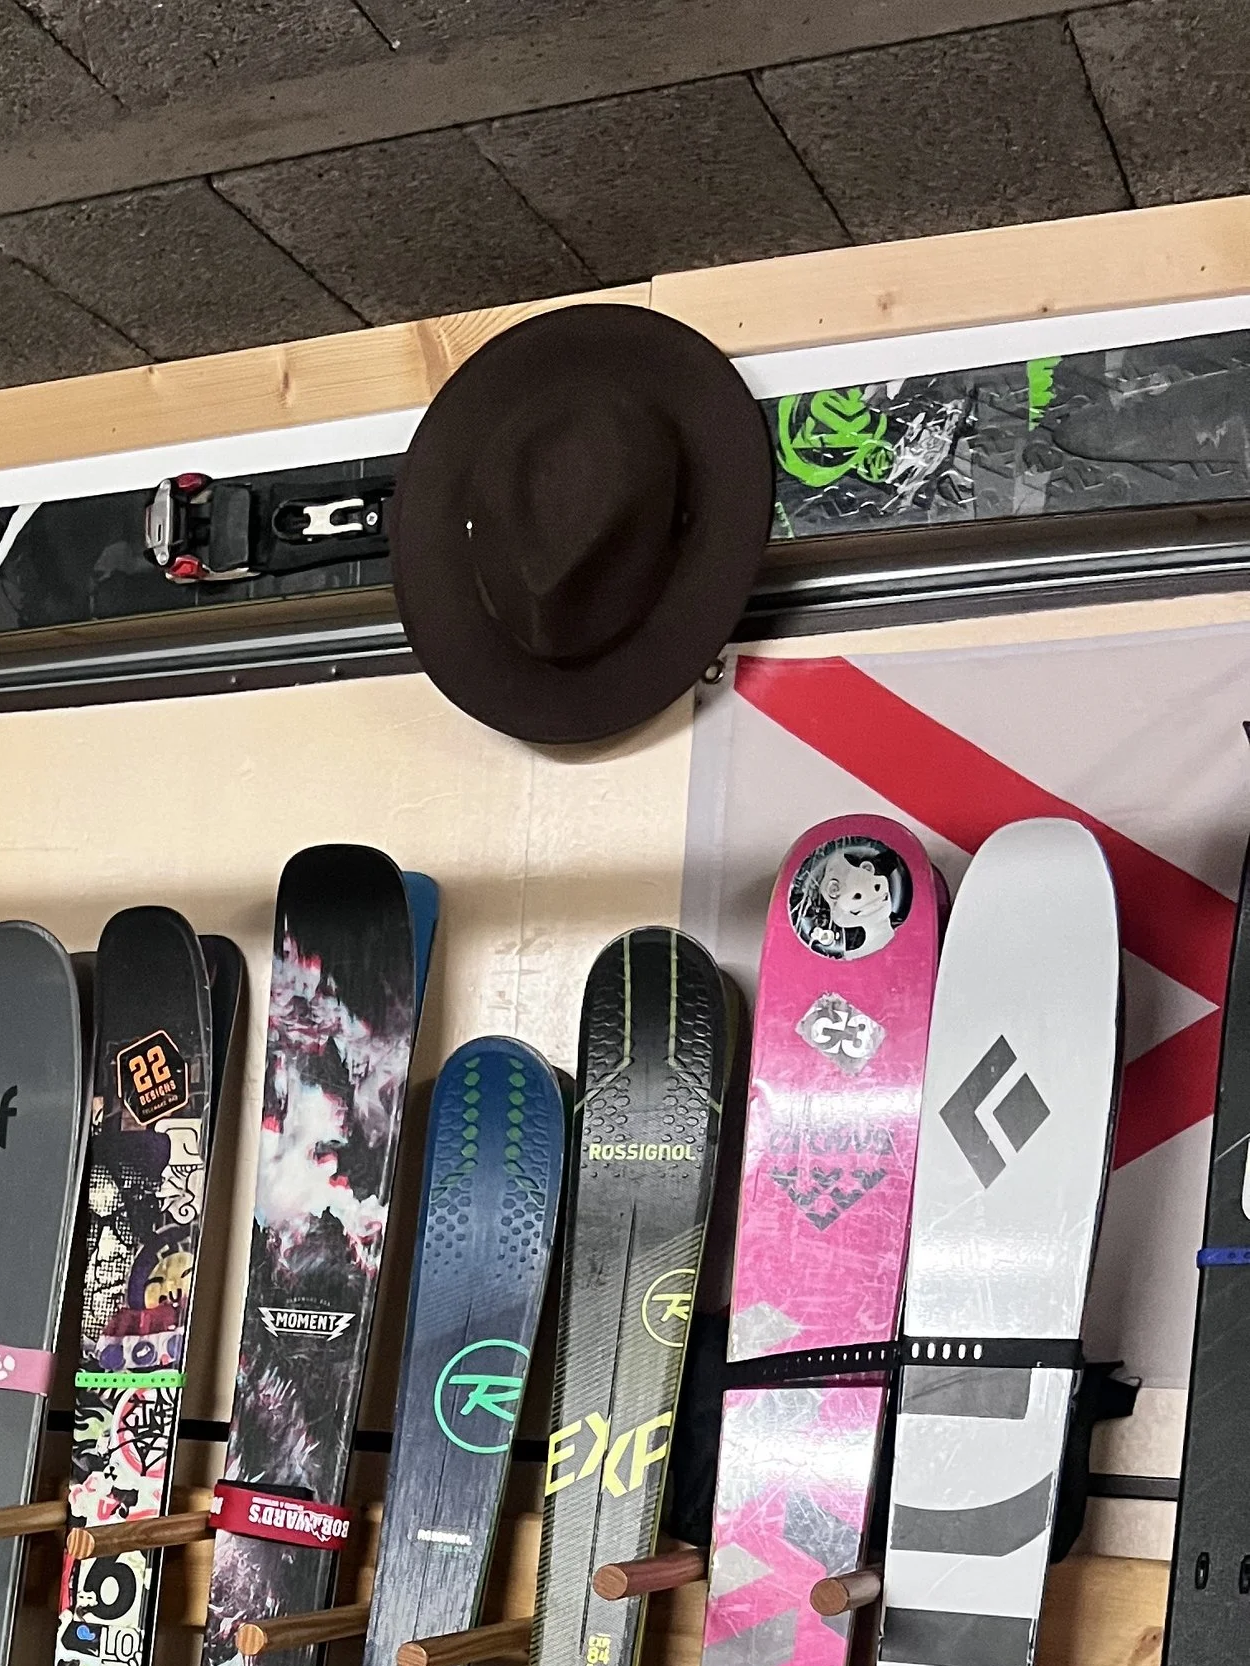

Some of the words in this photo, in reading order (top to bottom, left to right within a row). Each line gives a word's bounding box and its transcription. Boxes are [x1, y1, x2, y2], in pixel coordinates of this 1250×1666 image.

[811, 1008, 873, 1058] G3
[129, 1045, 172, 1093] 22
[139, 1080, 177, 1106] DESIGNS
[588, 1142, 697, 1161] ROSSIGNOL
[275, 1312, 337, 1331] MOMENT
